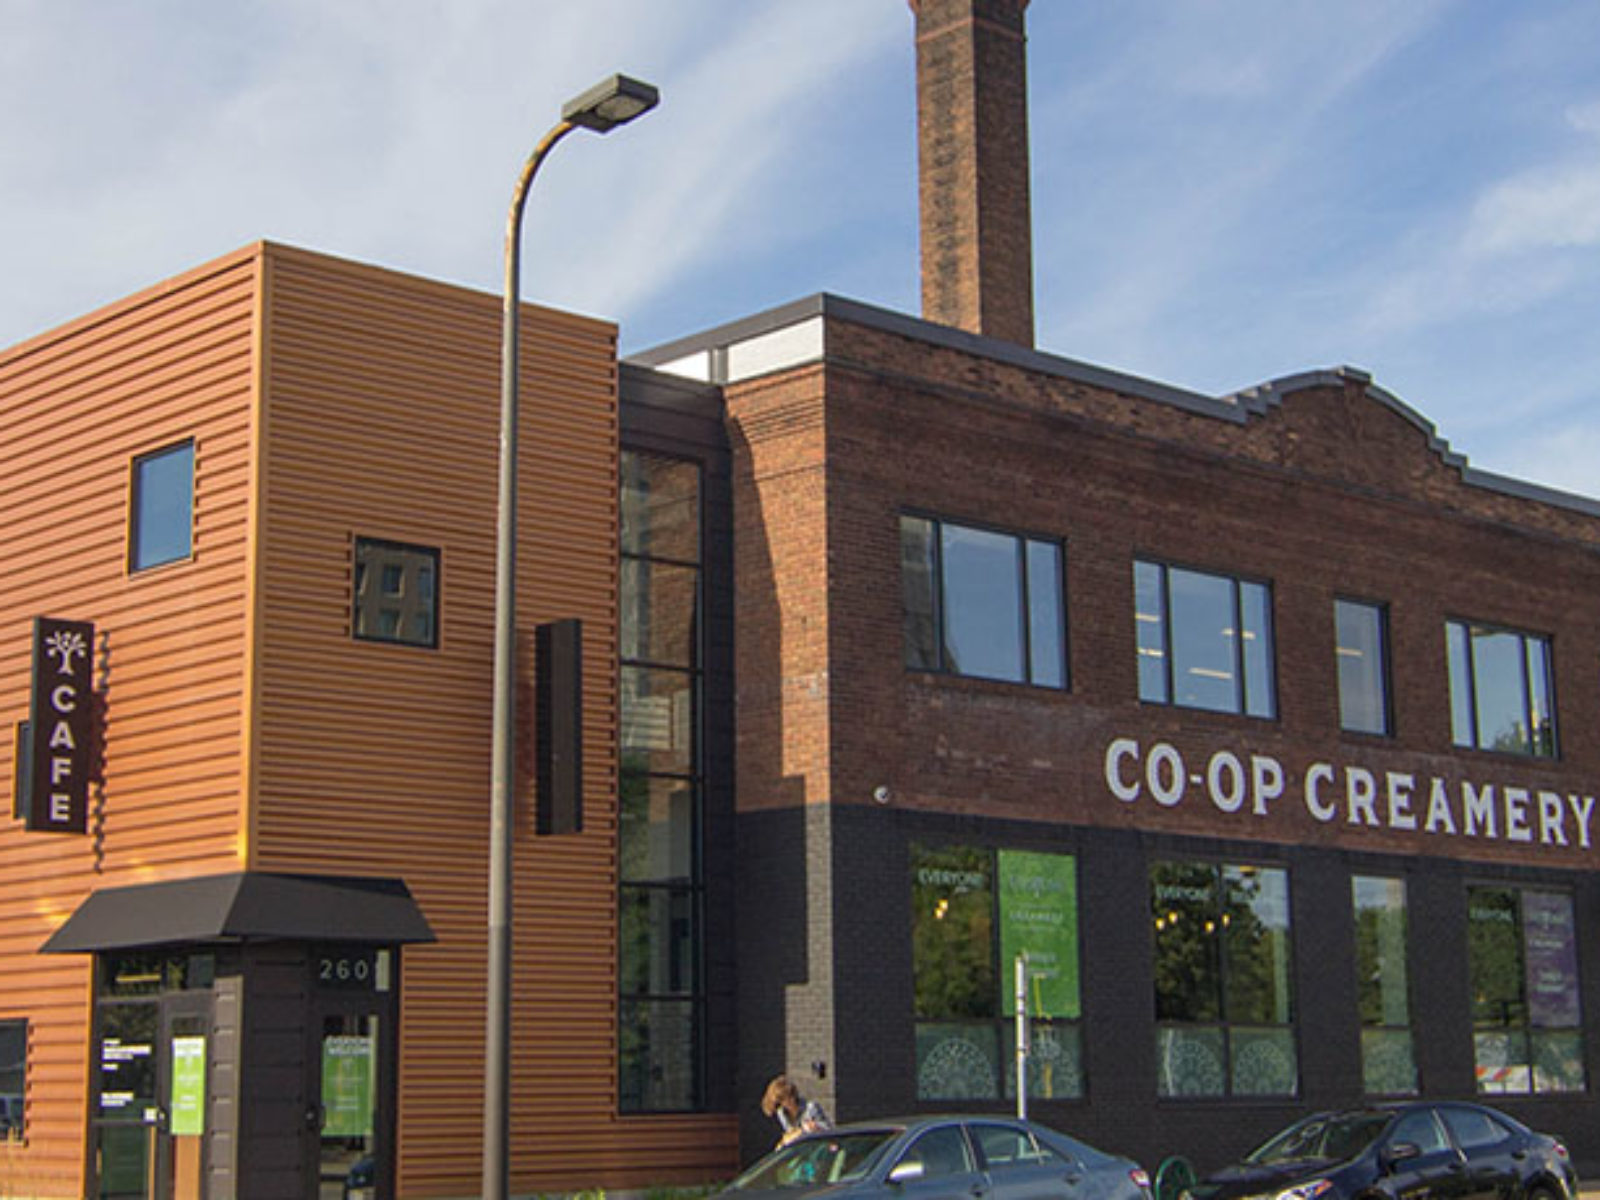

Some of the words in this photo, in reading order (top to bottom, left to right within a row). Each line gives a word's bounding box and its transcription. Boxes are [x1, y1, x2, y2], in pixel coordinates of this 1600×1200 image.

[50, 684, 76, 822] CAFE
[1105, 737, 1285, 815] CO-OP
[1303, 761, 1595, 848] CREAMERY
[320, 958, 369, 980] 260
